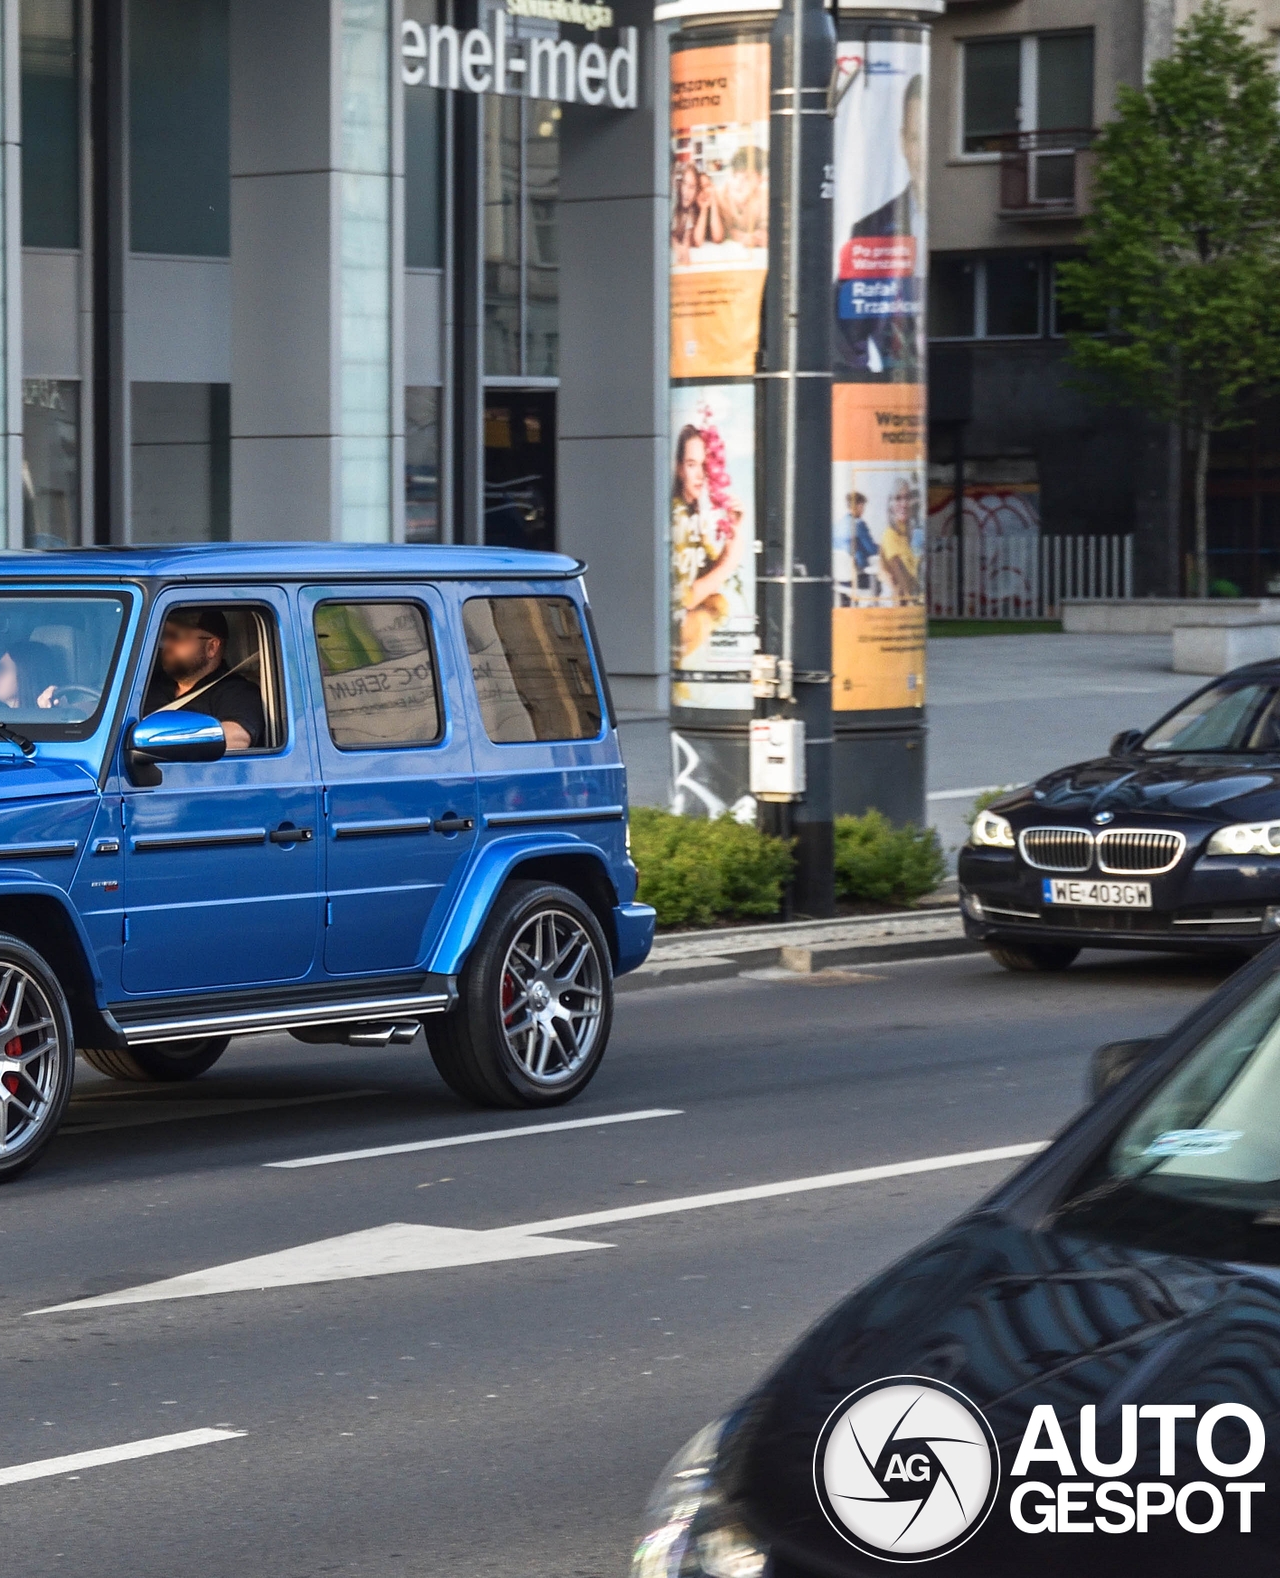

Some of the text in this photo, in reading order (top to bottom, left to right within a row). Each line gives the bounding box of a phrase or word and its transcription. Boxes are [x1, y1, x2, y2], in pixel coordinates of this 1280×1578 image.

[402, 9, 638, 109] enel-med
[1055, 883, 1082, 902] WE
[1088, 884, 1148, 904] 403GW
